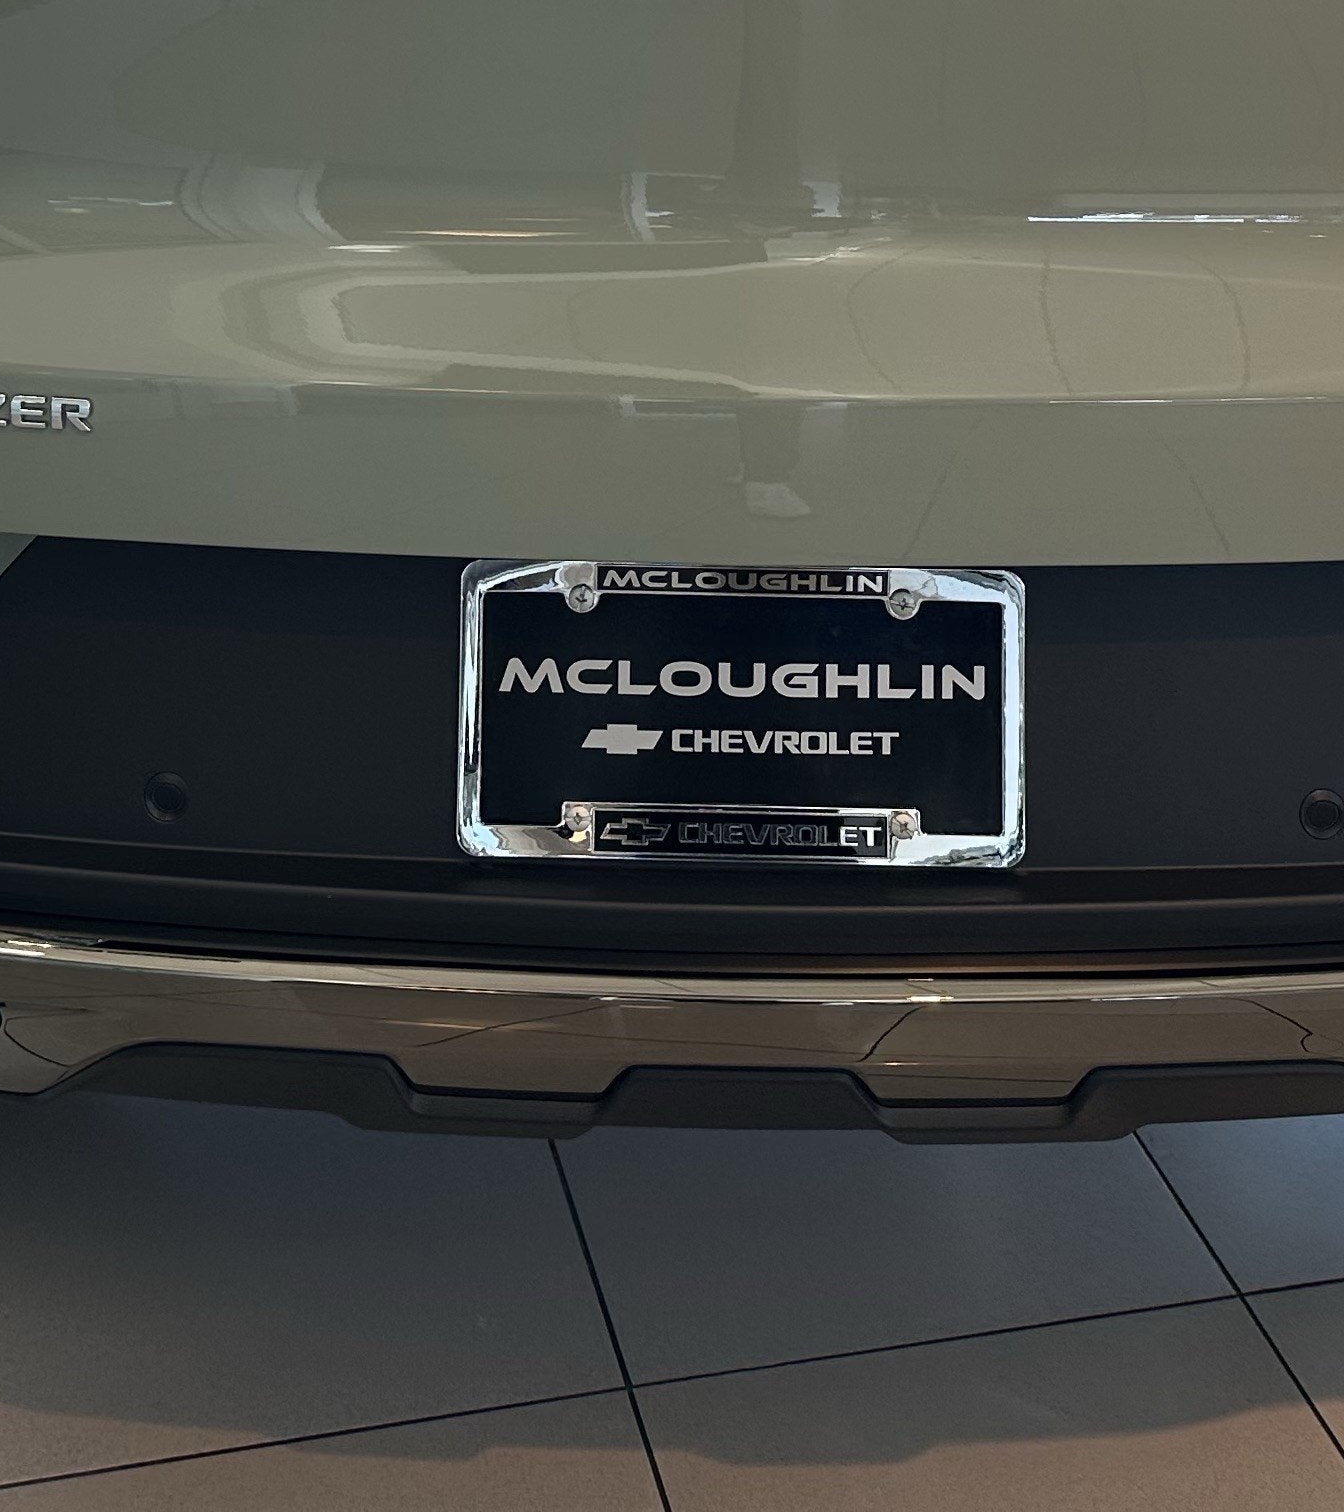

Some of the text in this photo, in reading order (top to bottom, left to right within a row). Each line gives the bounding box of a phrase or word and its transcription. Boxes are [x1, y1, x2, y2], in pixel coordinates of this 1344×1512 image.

[602, 569, 885, 593] MCLOUGHLIN
[499, 657, 986, 701] MCLOUGHLIN
[671, 729, 900, 756] CHEVROLET
[678, 821, 883, 848] CHEVROLET
